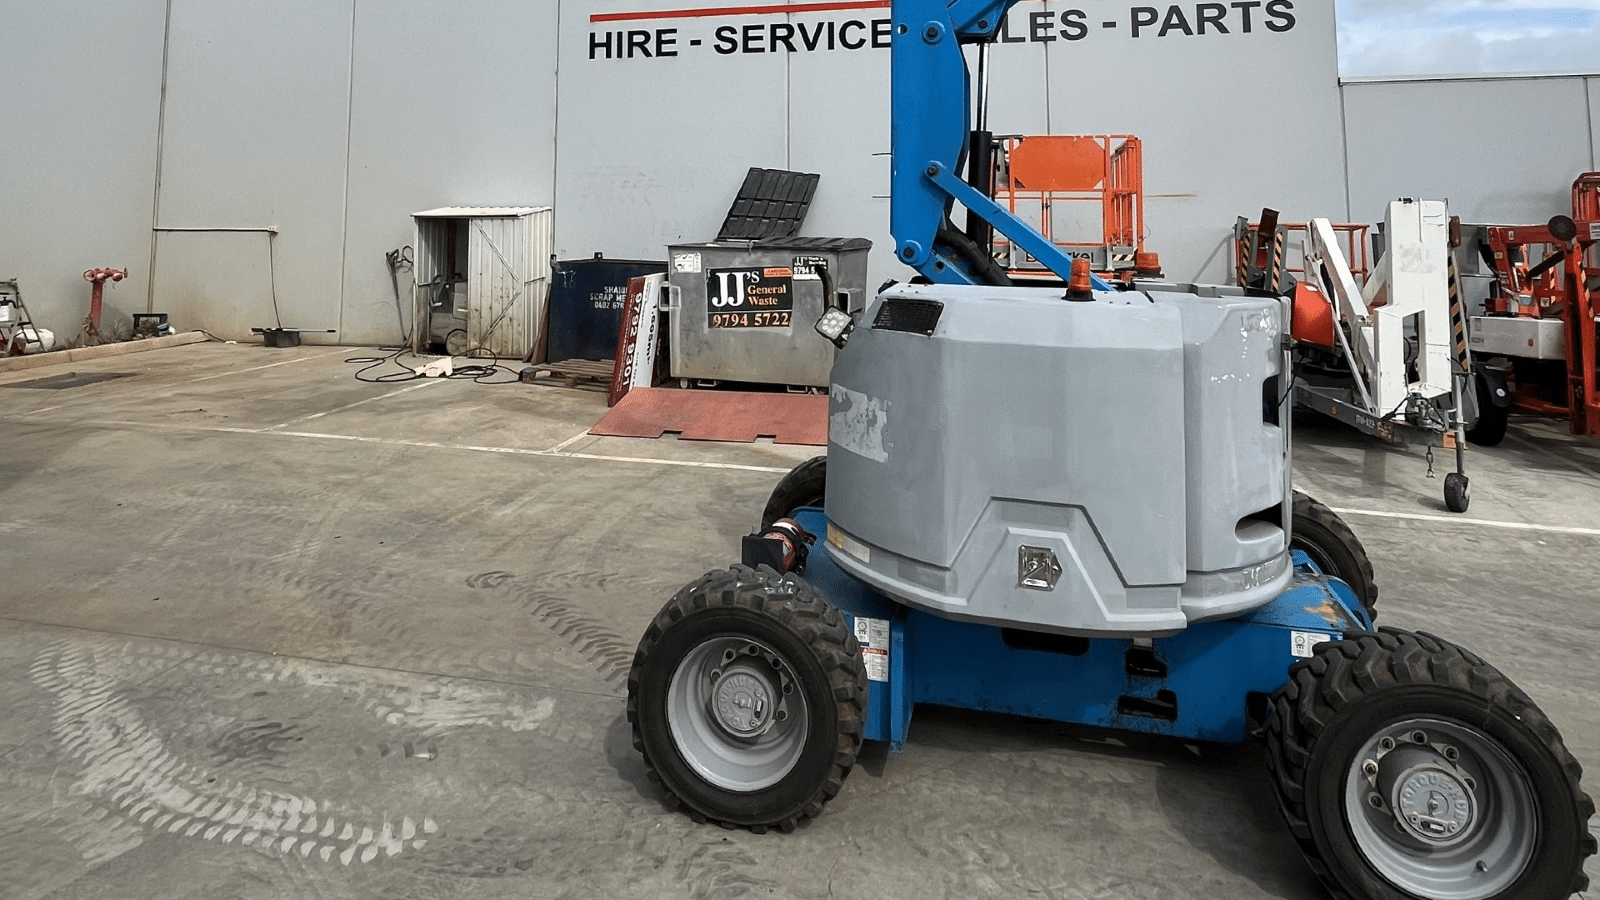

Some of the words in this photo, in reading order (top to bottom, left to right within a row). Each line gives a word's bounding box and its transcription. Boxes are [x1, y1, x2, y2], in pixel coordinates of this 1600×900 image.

[589, 28, 678, 59] HIRE
[991, 9, 1088, 43] LES
[1130, 0, 1297, 38] PARTS
[589, 292, 614, 302] SCRAP
[747, 284, 787, 295] General
[748, 295, 778, 306] Waste
[629, 292, 643, 338] 9792
[712, 313, 748, 327] 9794
[754, 312, 789, 327] 5722
[622, 342, 635, 386] 9301
